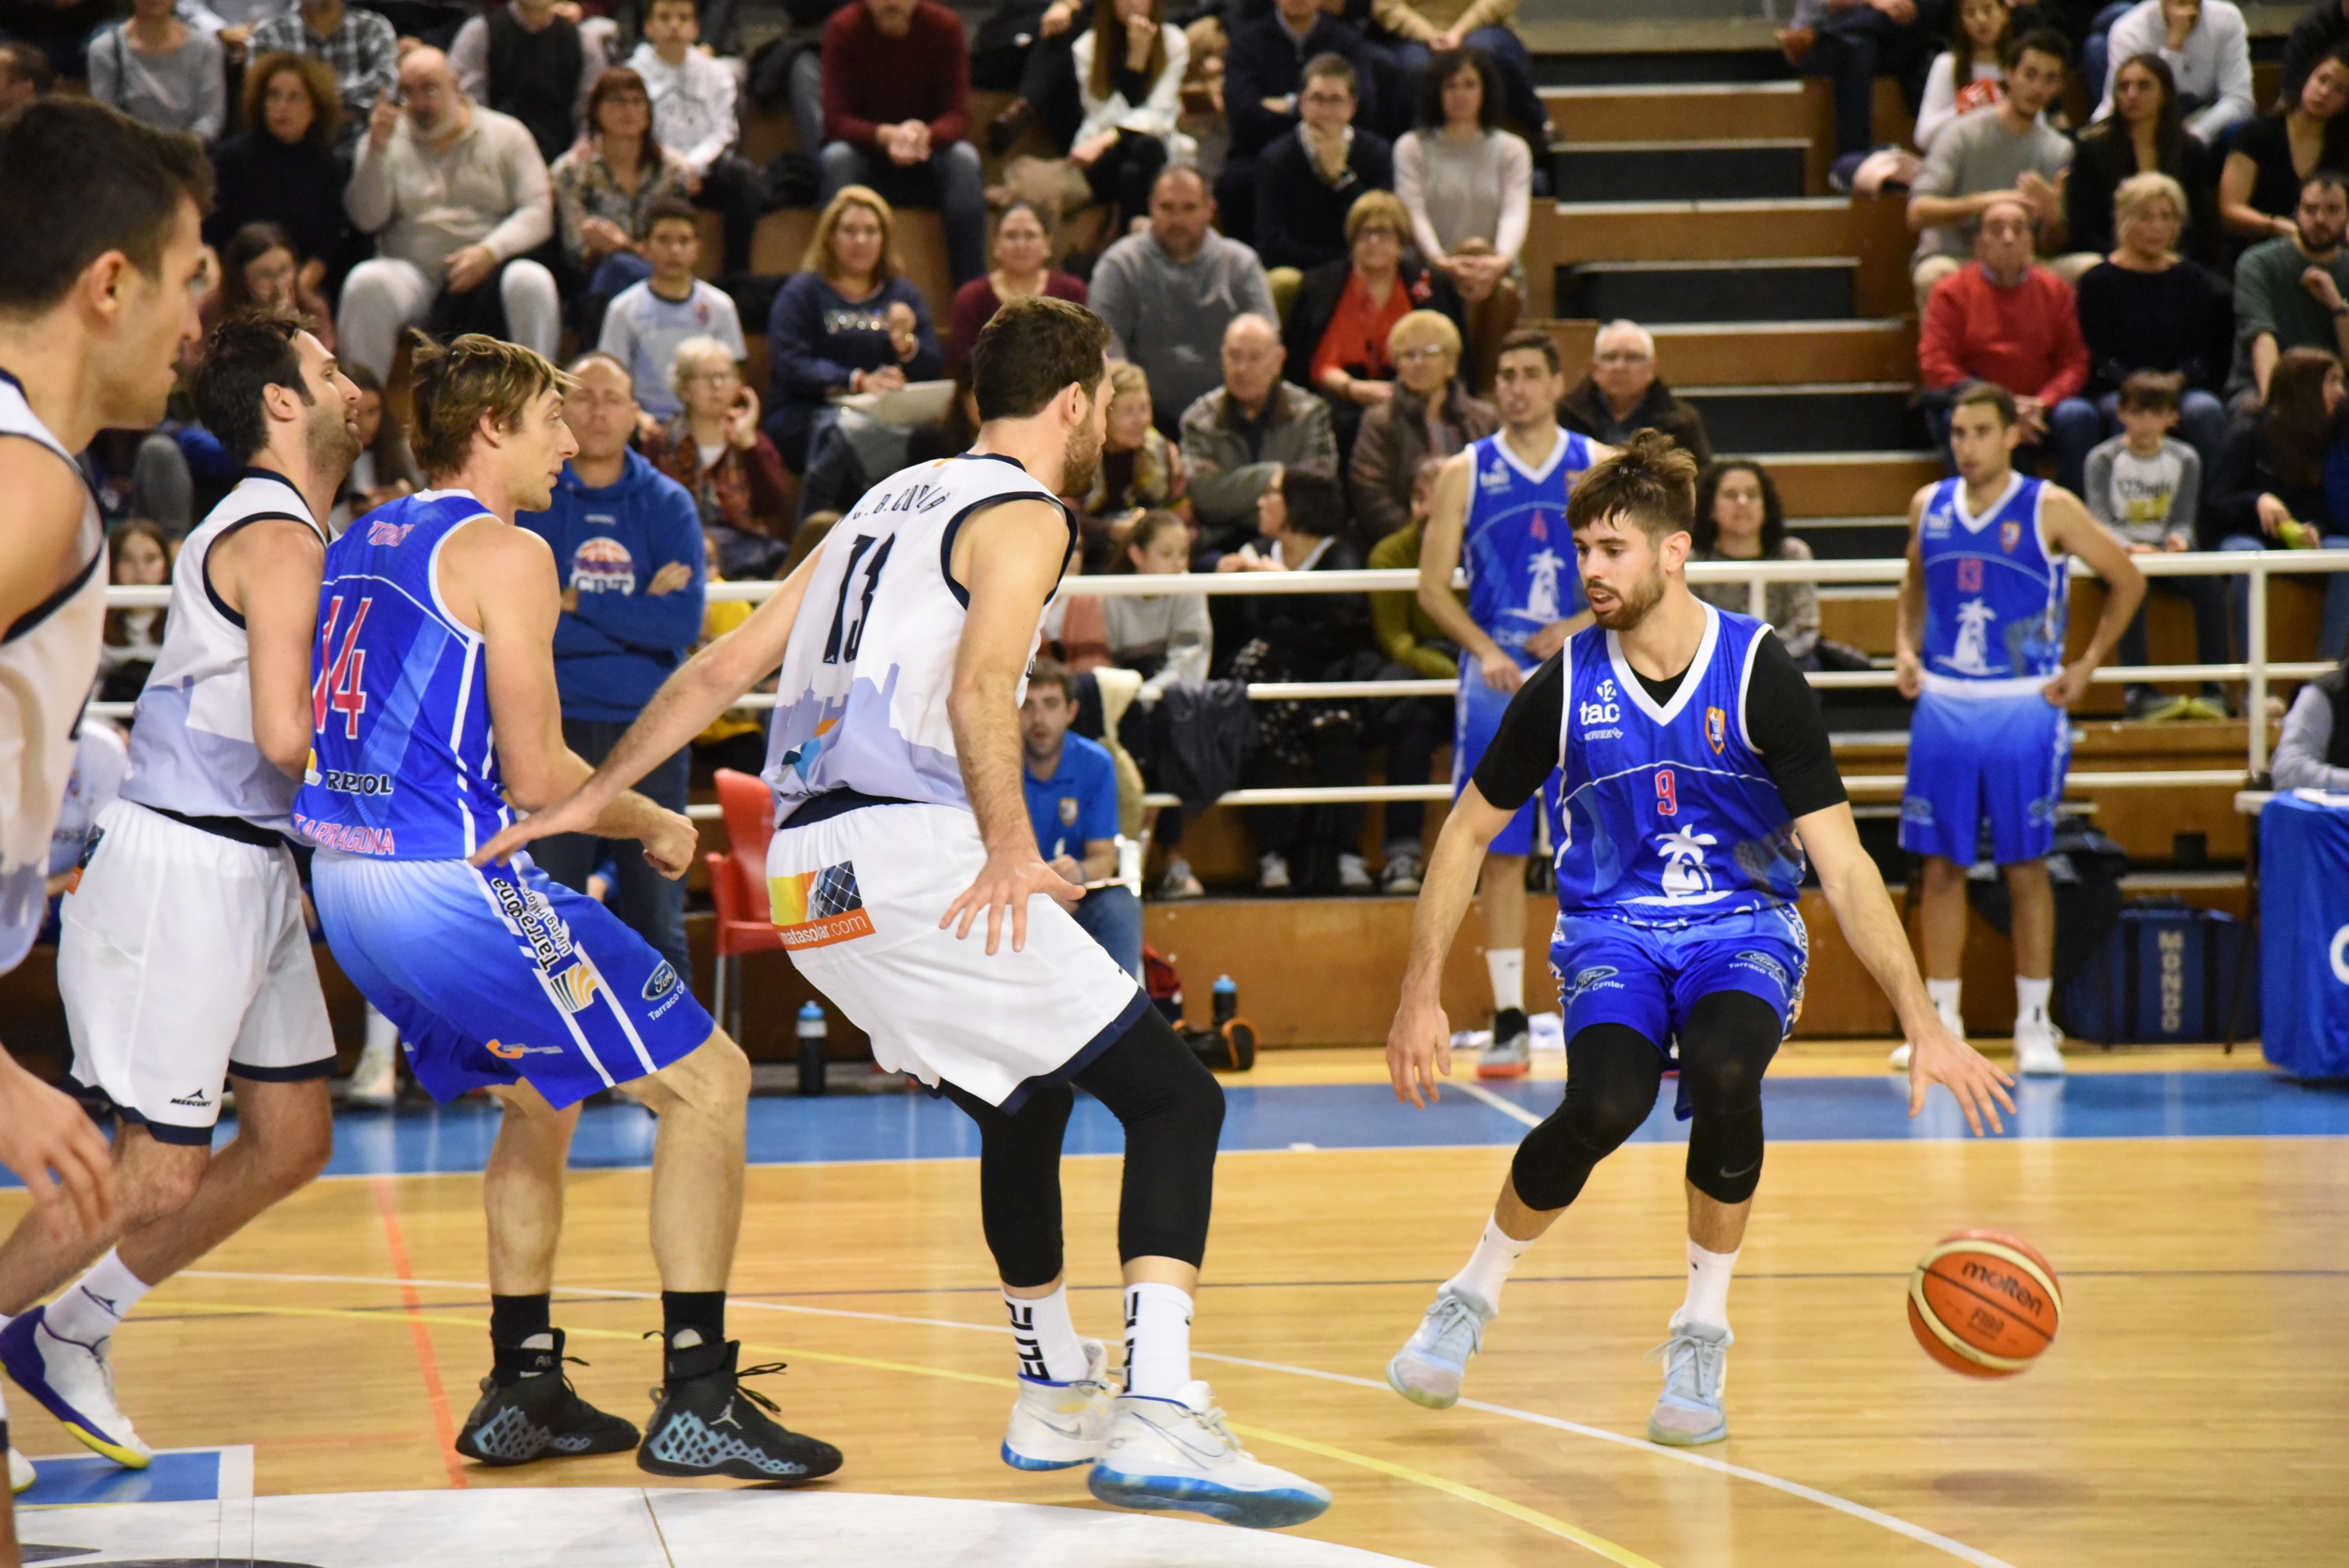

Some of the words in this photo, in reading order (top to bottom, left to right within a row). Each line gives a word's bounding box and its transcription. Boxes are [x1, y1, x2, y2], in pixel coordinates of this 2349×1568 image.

[822, 531, 896, 664] 13
[312, 595, 373, 739] 14
[1580, 700, 1620, 725] tac
[1654, 769, 1677, 816] 9
[294, 812, 395, 855] TARRAGONA
[492, 878, 559, 971] Tarragona
[546, 915, 572, 956] Living
[654, 966, 675, 994] Ford
[1728, 962, 1766, 975] Tarraco
[2158, 930, 2184, 1033] MONDO
[647, 992, 680, 1021] Tarraco
[1962, 1261, 2043, 1318] molten
